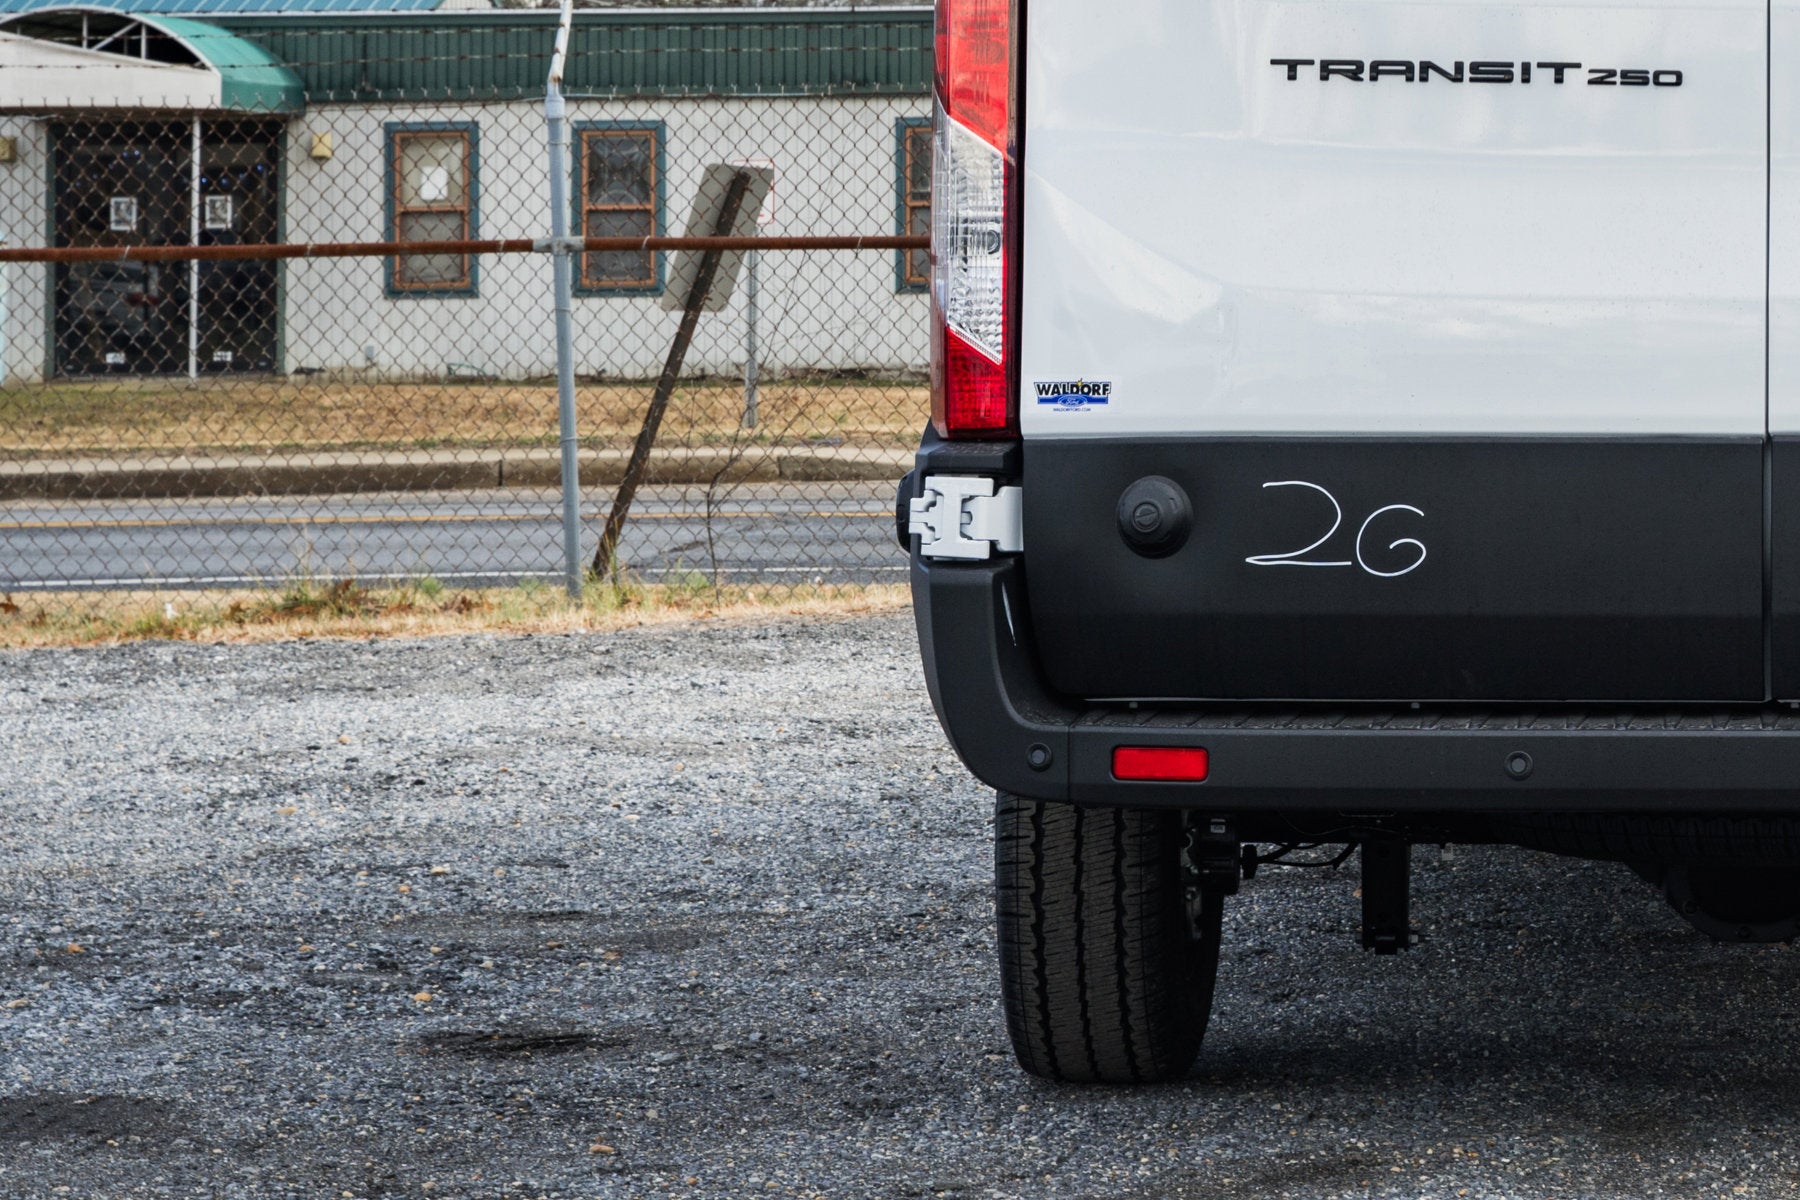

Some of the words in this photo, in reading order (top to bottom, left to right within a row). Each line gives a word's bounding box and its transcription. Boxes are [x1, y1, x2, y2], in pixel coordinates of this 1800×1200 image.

[1269, 58, 1582, 85] TRANSIT
[1587, 68, 1684, 87] 250
[1035, 382, 1111, 396] WALDORF
